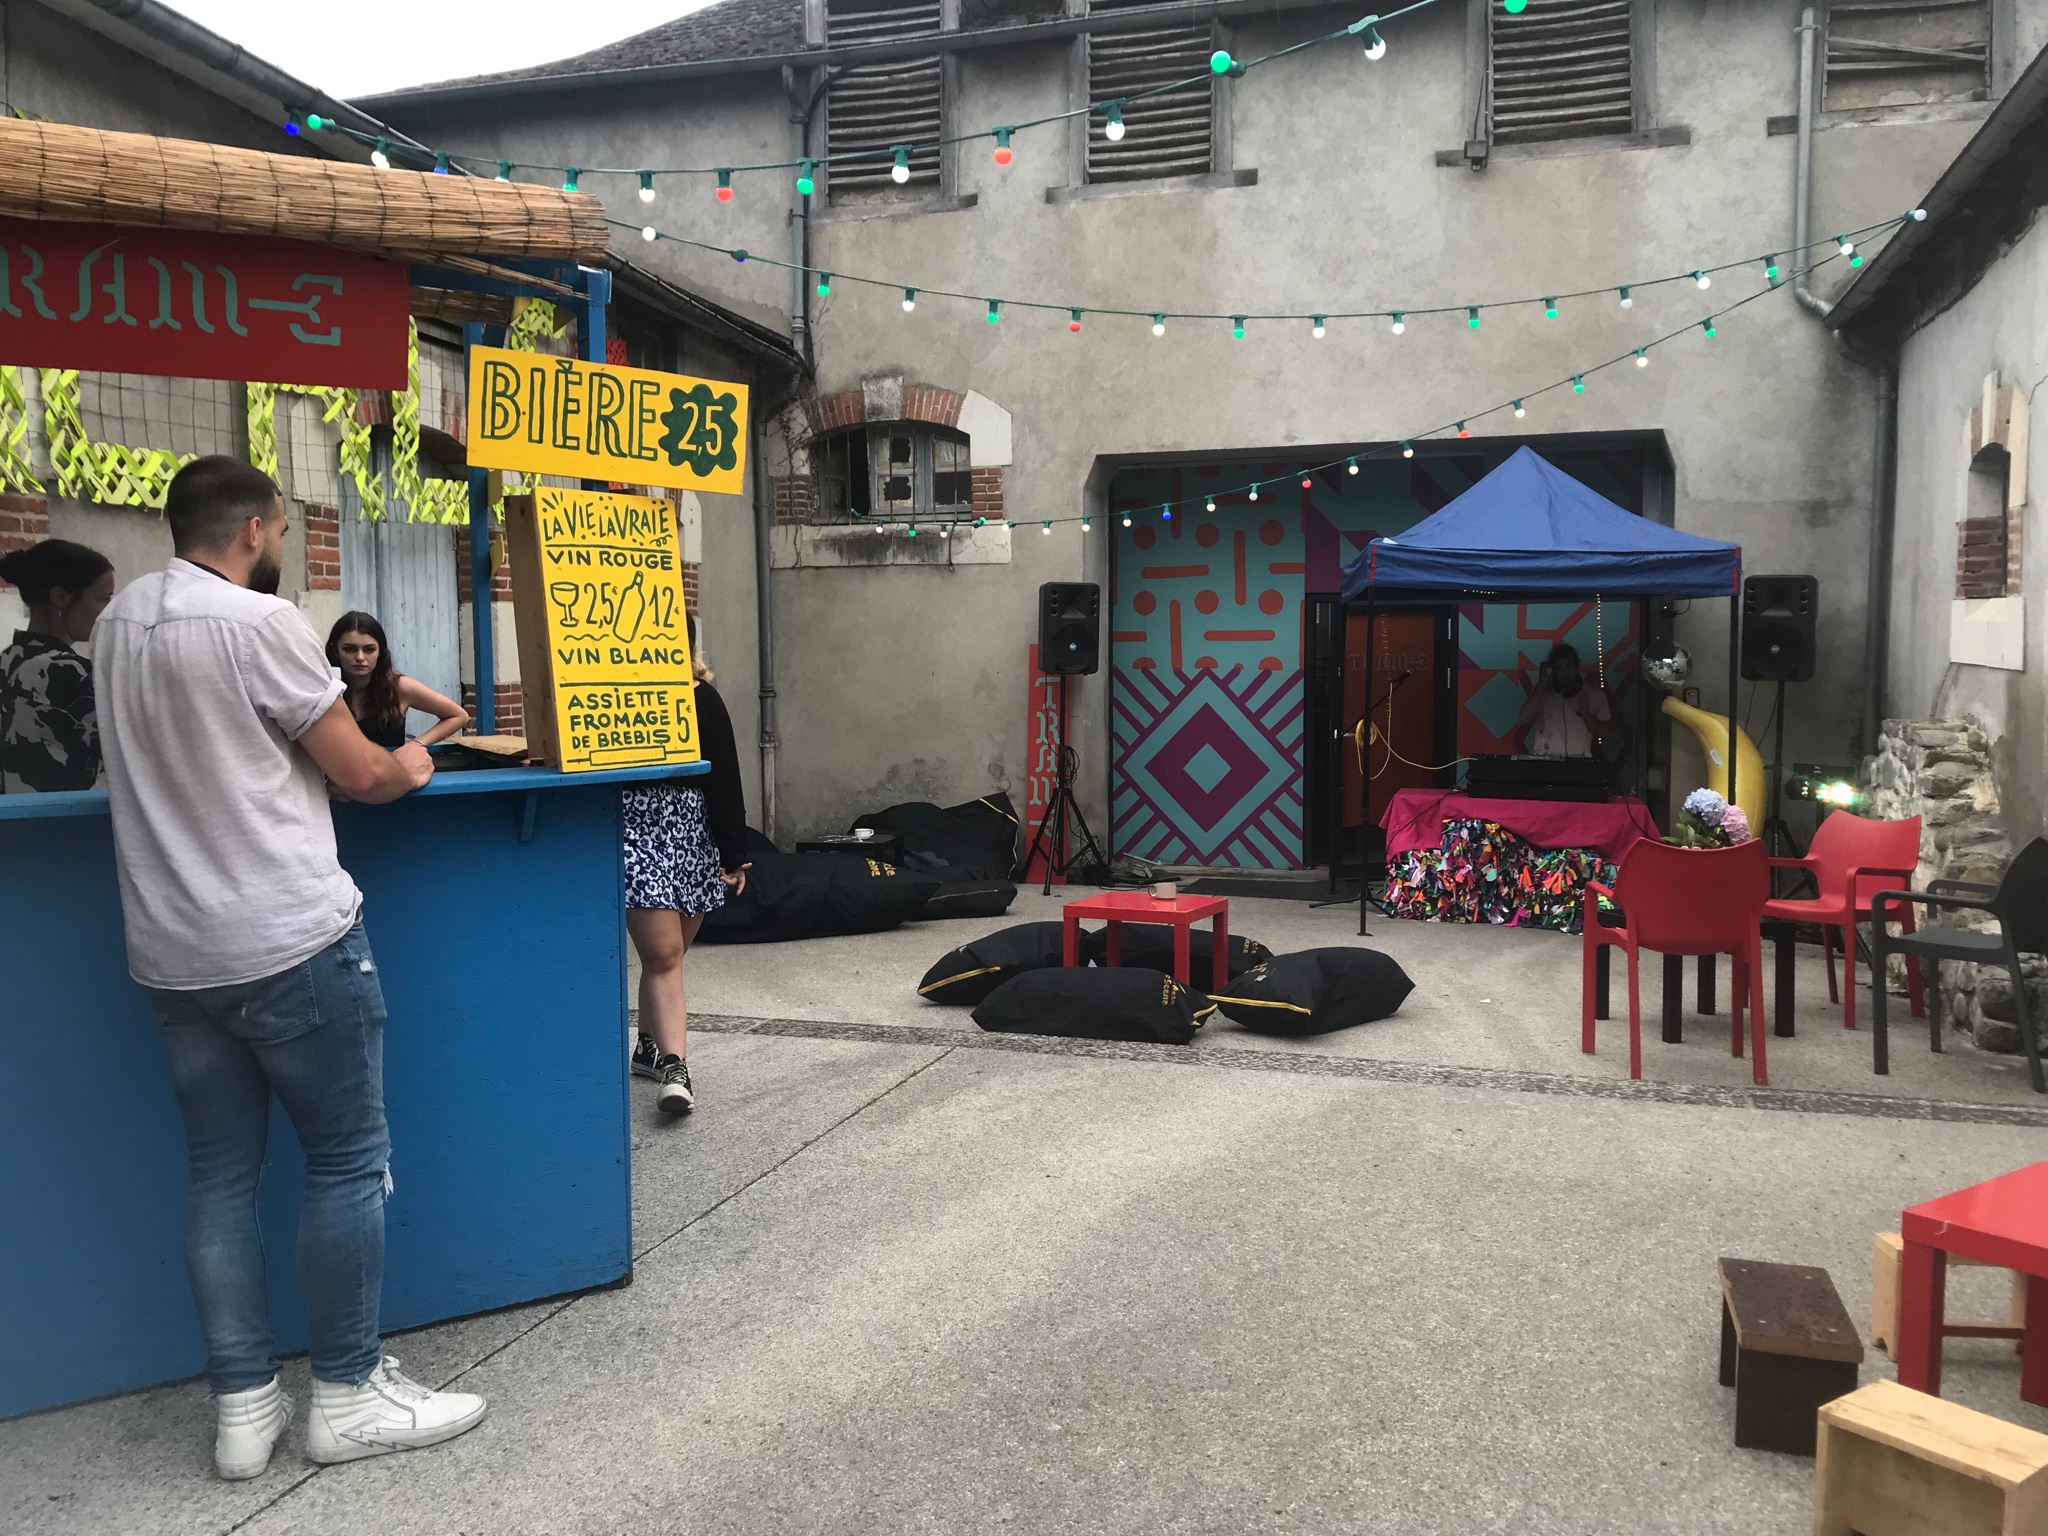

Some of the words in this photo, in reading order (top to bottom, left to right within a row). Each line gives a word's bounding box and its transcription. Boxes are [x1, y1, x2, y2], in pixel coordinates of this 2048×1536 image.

[480, 359, 661, 461] BIÈRE
[677, 401, 723, 456] 2,5
[543, 516, 564, 541] LA
[563, 500, 596, 539] VIE
[599, 515, 616, 538] LA
[612, 504, 670, 540] VRAIE
[547, 550, 592, 566] VIN
[599, 550, 673, 570] ROUGE
[557, 647, 601, 665] VIN
[609, 647, 685, 665] BLANC
[570, 709, 671, 732] FROMAGE
[571, 735, 590, 749] DE
[597, 729, 671, 748] BREBIS
